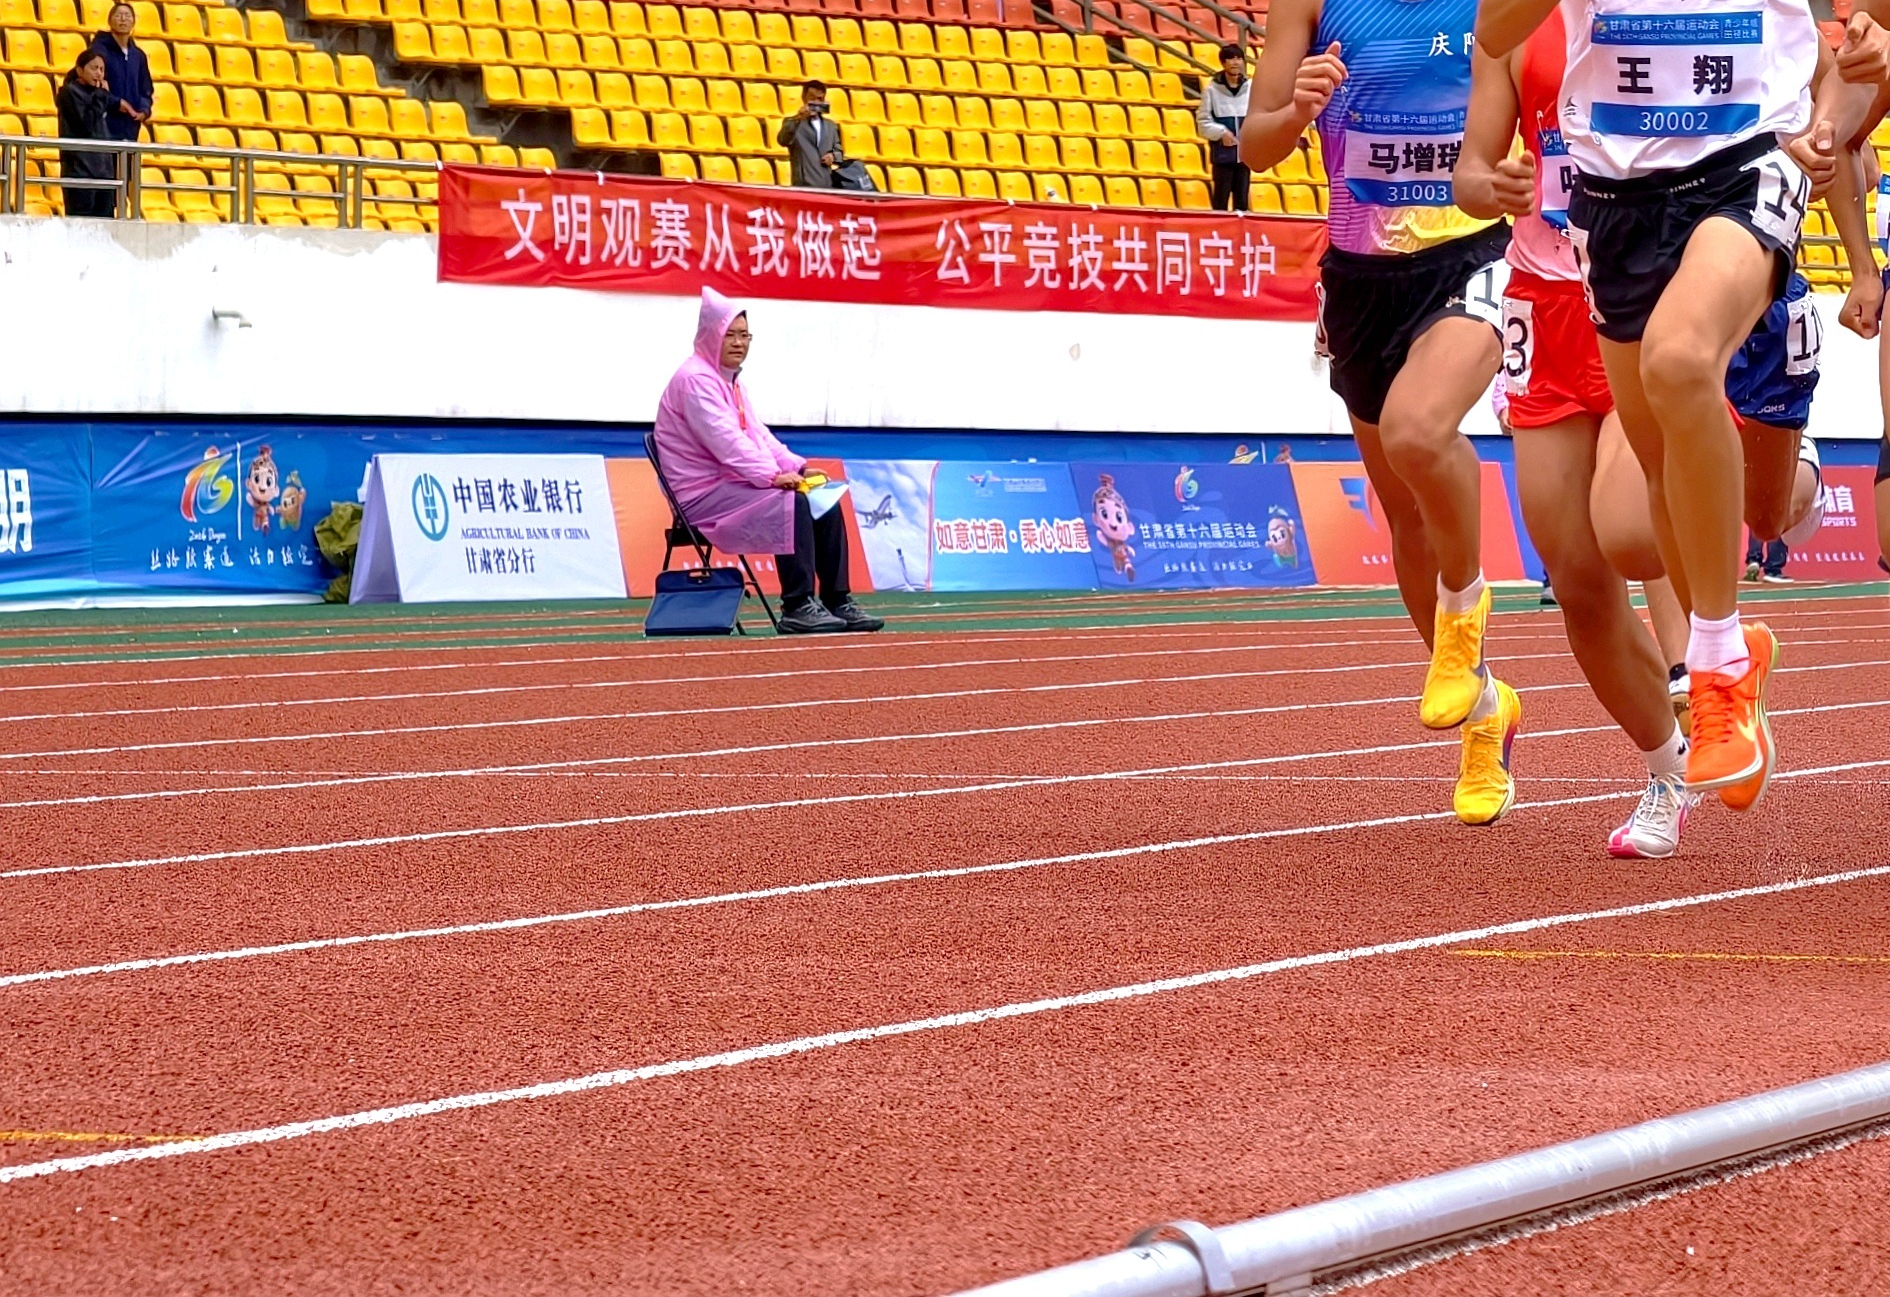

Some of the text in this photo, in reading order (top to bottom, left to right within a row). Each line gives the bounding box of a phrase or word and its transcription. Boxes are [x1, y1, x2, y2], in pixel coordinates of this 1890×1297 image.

[1610, 19, 1720, 31] 甘肃省第十六届运动会
[1617, 55, 1733, 94] 王翔
[1639, 112, 1708, 131] 30002
[1387, 185, 1447, 202] 31003
[501, 188, 1276, 297] 文明观赛从我做起 公平竞技共同守护
[452, 477, 583, 514] 中国农业银行
[460, 528, 590, 540] AGRICULTURAL BANK OF CHINA
[1139, 523, 1257, 539] 甘肃省第十六届运动会
[465, 546, 535, 574] 甘肃省分行
